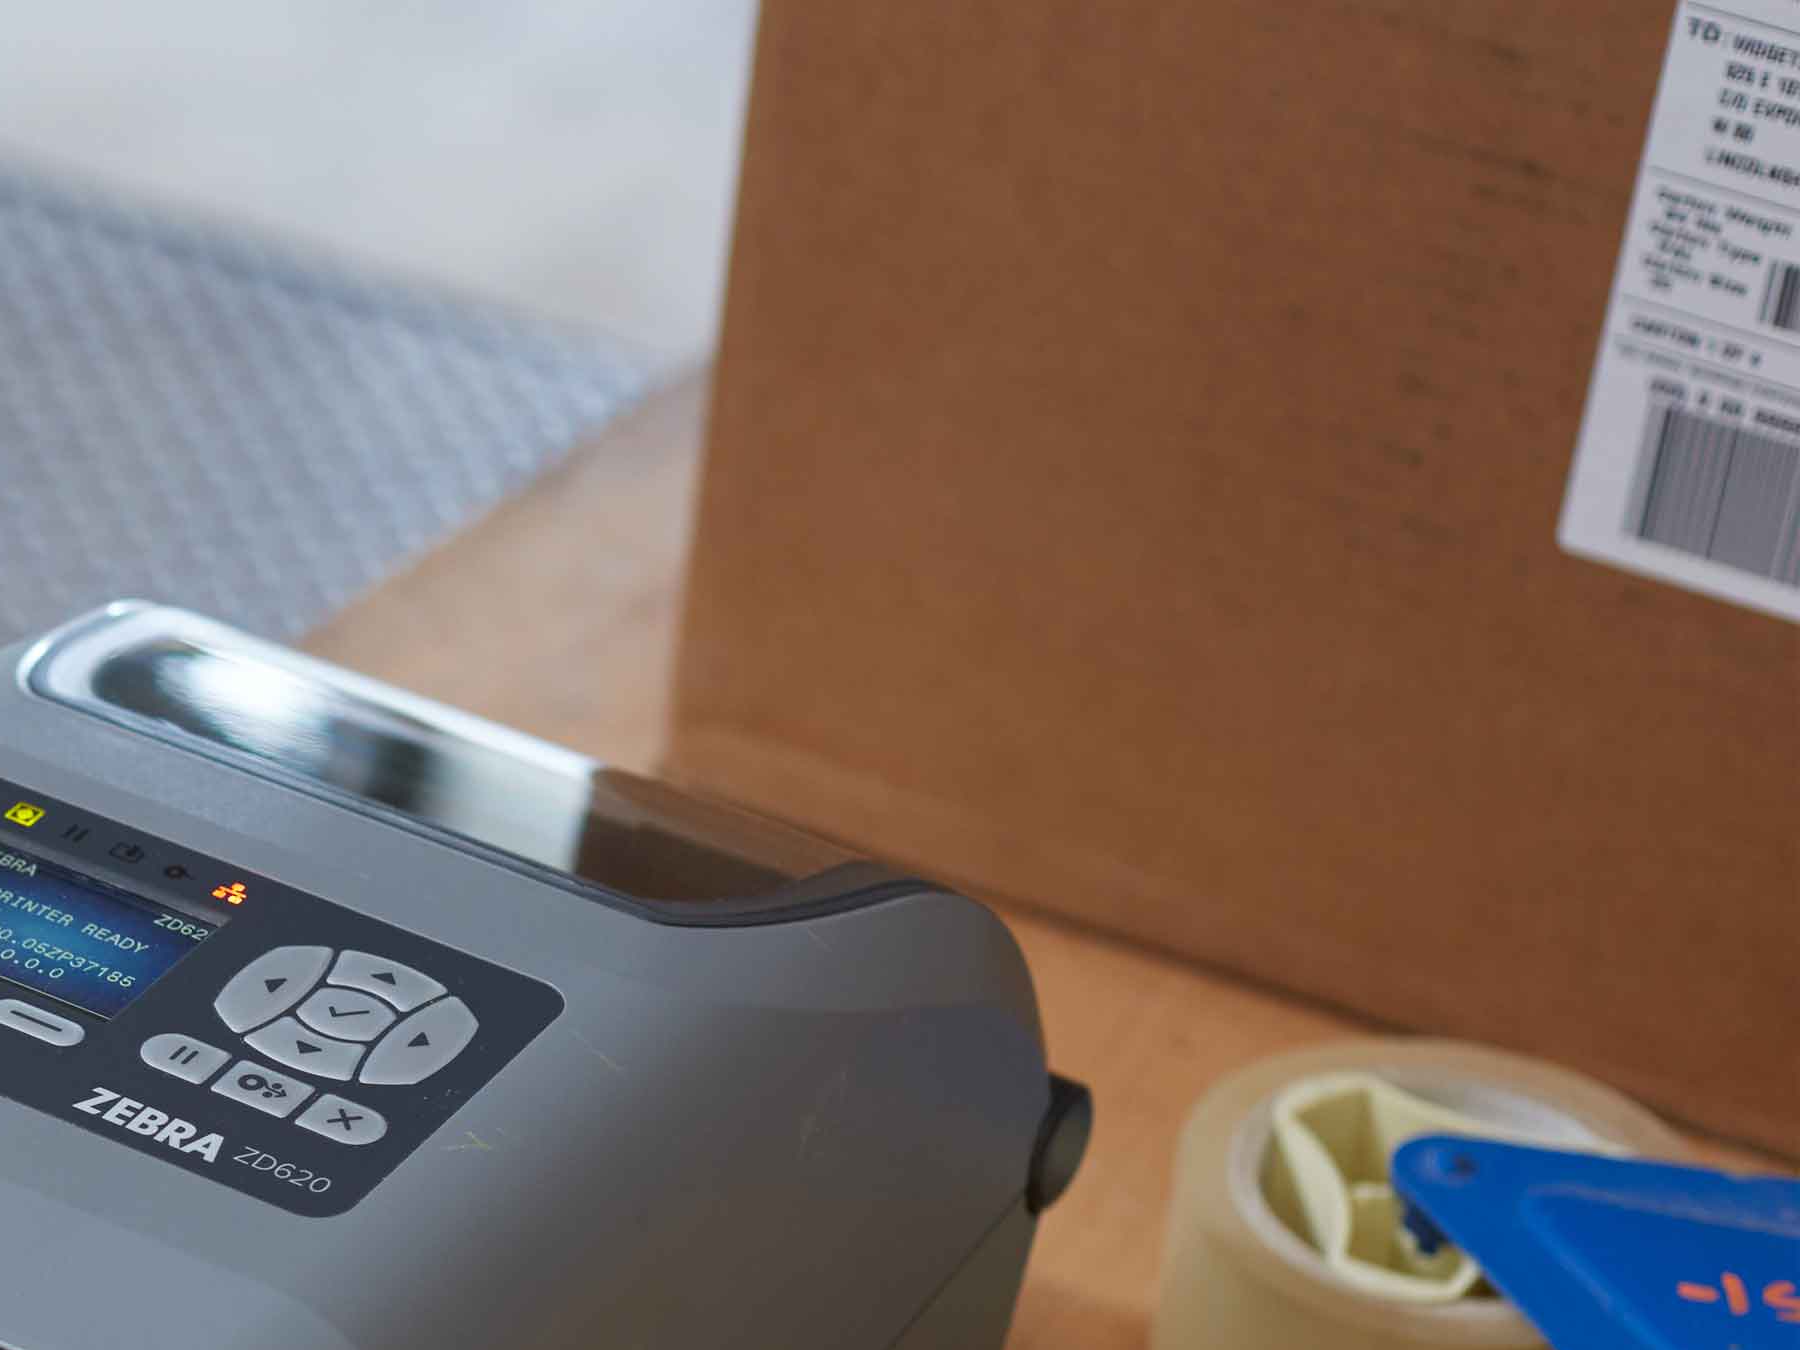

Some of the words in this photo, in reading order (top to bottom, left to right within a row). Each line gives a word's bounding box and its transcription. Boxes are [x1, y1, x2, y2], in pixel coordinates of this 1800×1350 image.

[81, 923, 149, 954] READY
[72, 1087, 225, 1163] ZEBRA
[233, 1146, 332, 1193] ZD620
